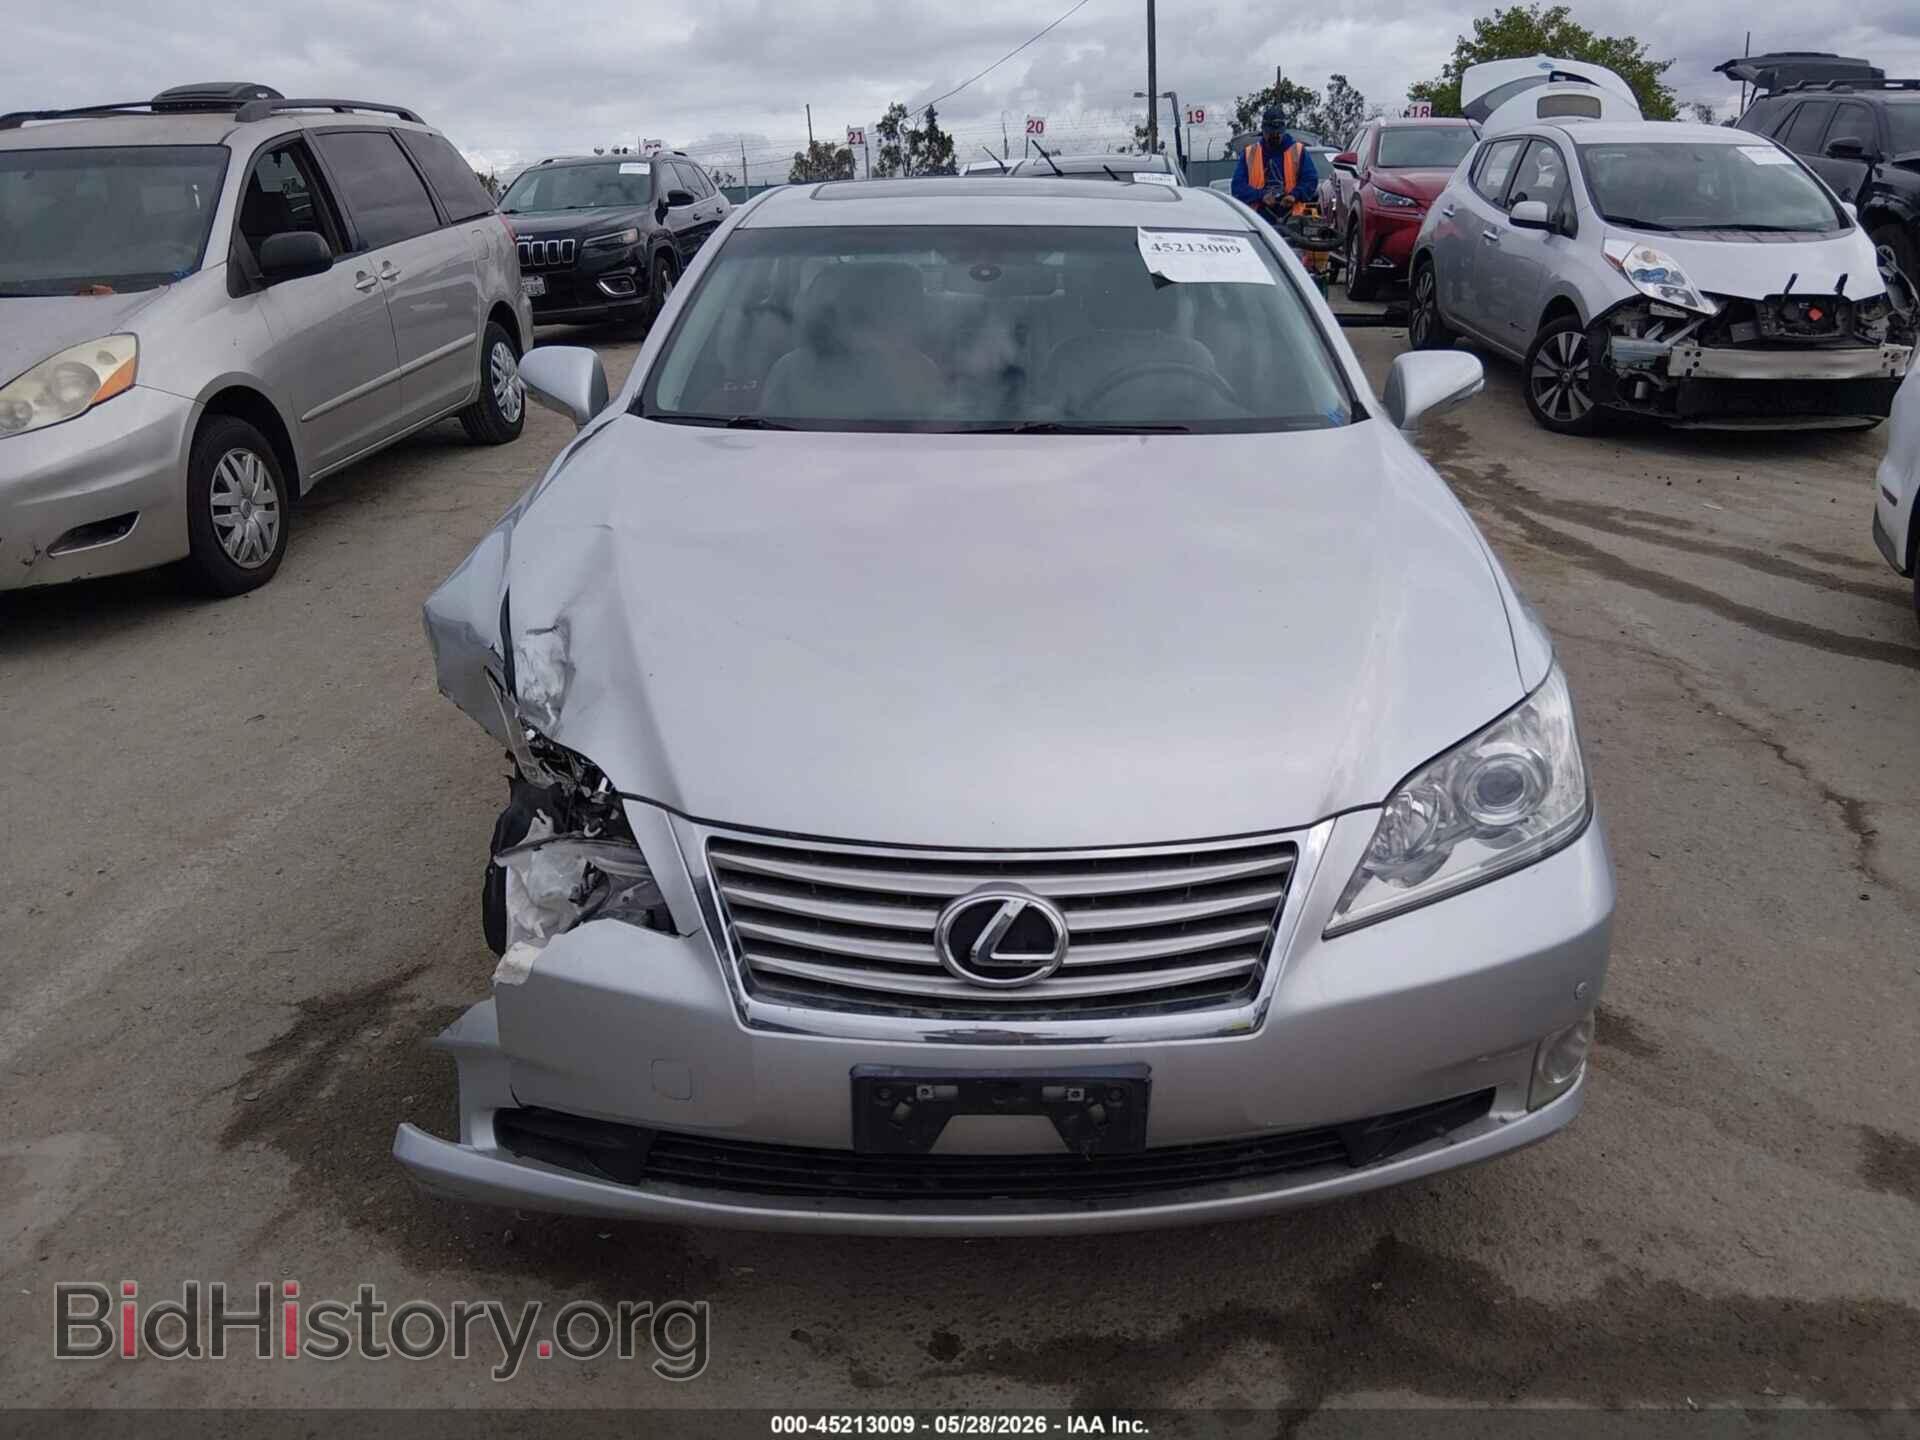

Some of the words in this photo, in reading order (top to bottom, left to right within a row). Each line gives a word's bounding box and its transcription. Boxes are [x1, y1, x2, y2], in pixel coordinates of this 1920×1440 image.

[1186, 110, 1205, 124] 19
[1411, 105, 1430, 118] 18
[1026, 119, 1044, 134] 20
[847, 131, 864, 145] 21
[1150, 242, 1241, 256] 45213009
